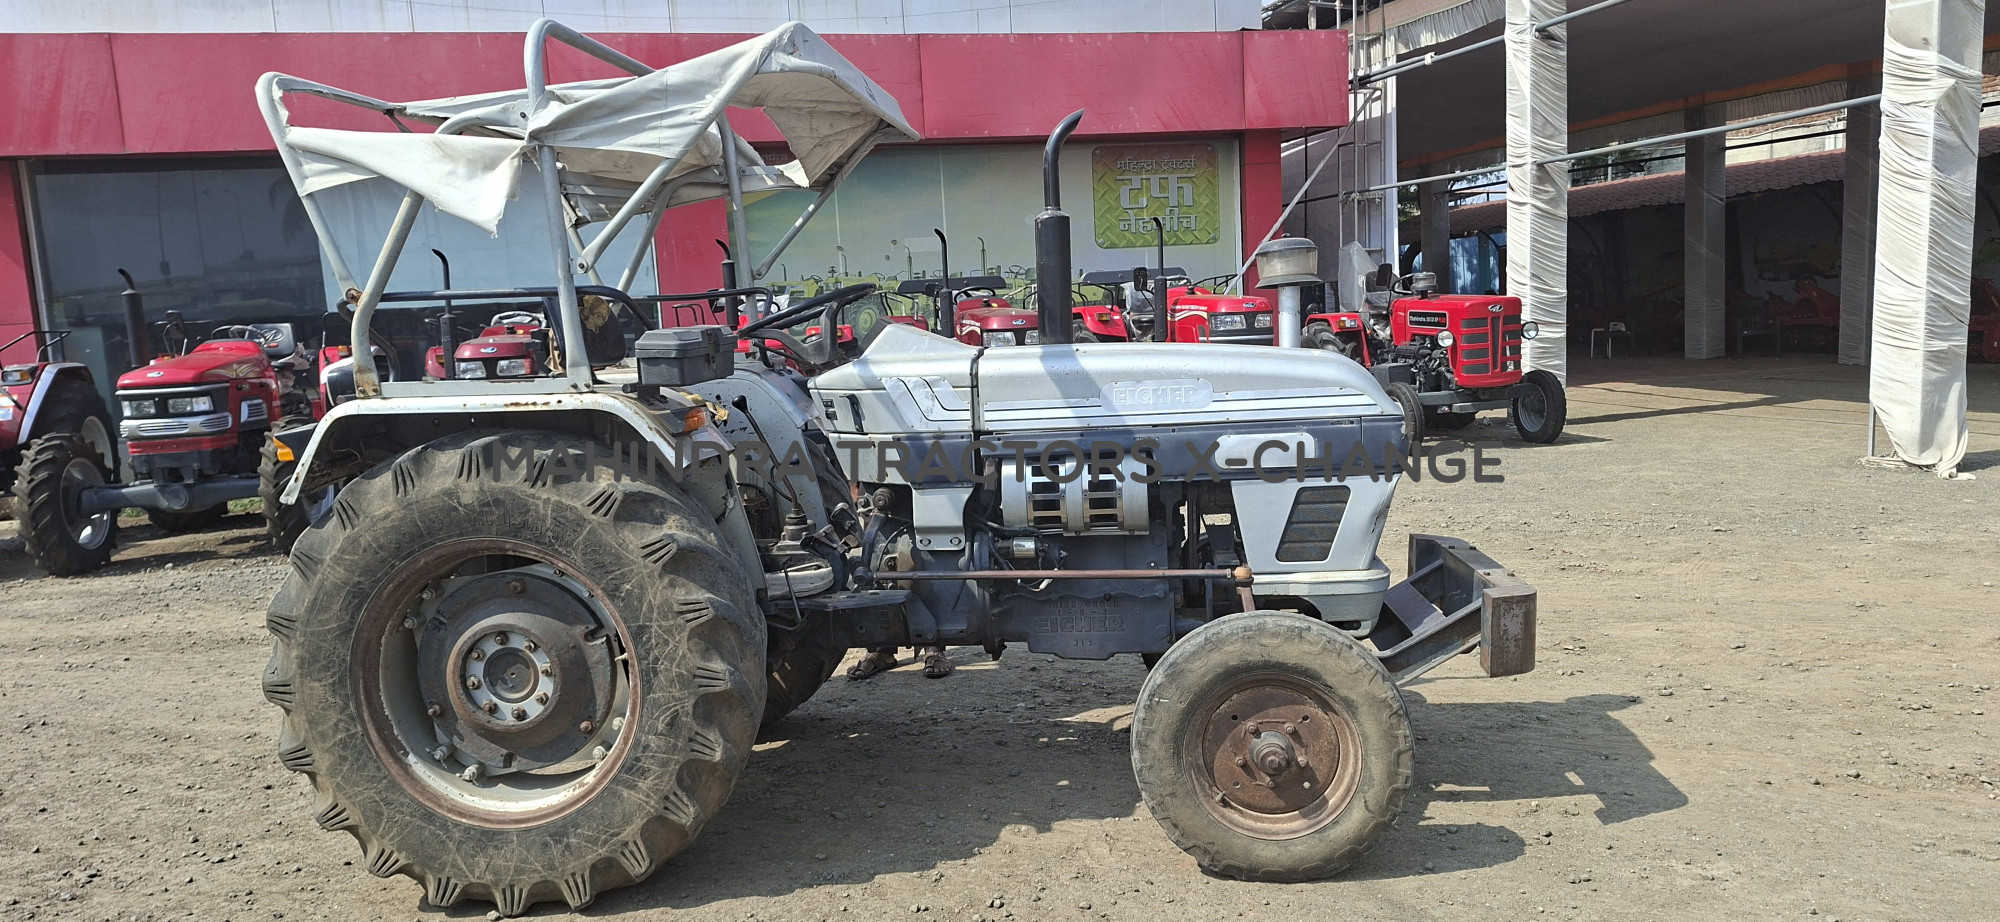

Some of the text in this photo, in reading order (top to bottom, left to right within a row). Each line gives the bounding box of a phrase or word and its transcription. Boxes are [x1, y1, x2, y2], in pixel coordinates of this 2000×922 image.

[1116, 157, 1157, 171] महिन्द्रा
[1116, 173, 1196, 208] टफ
[1113, 385, 1199, 406] EICHER
[1034, 616, 1125, 633] EICHER
